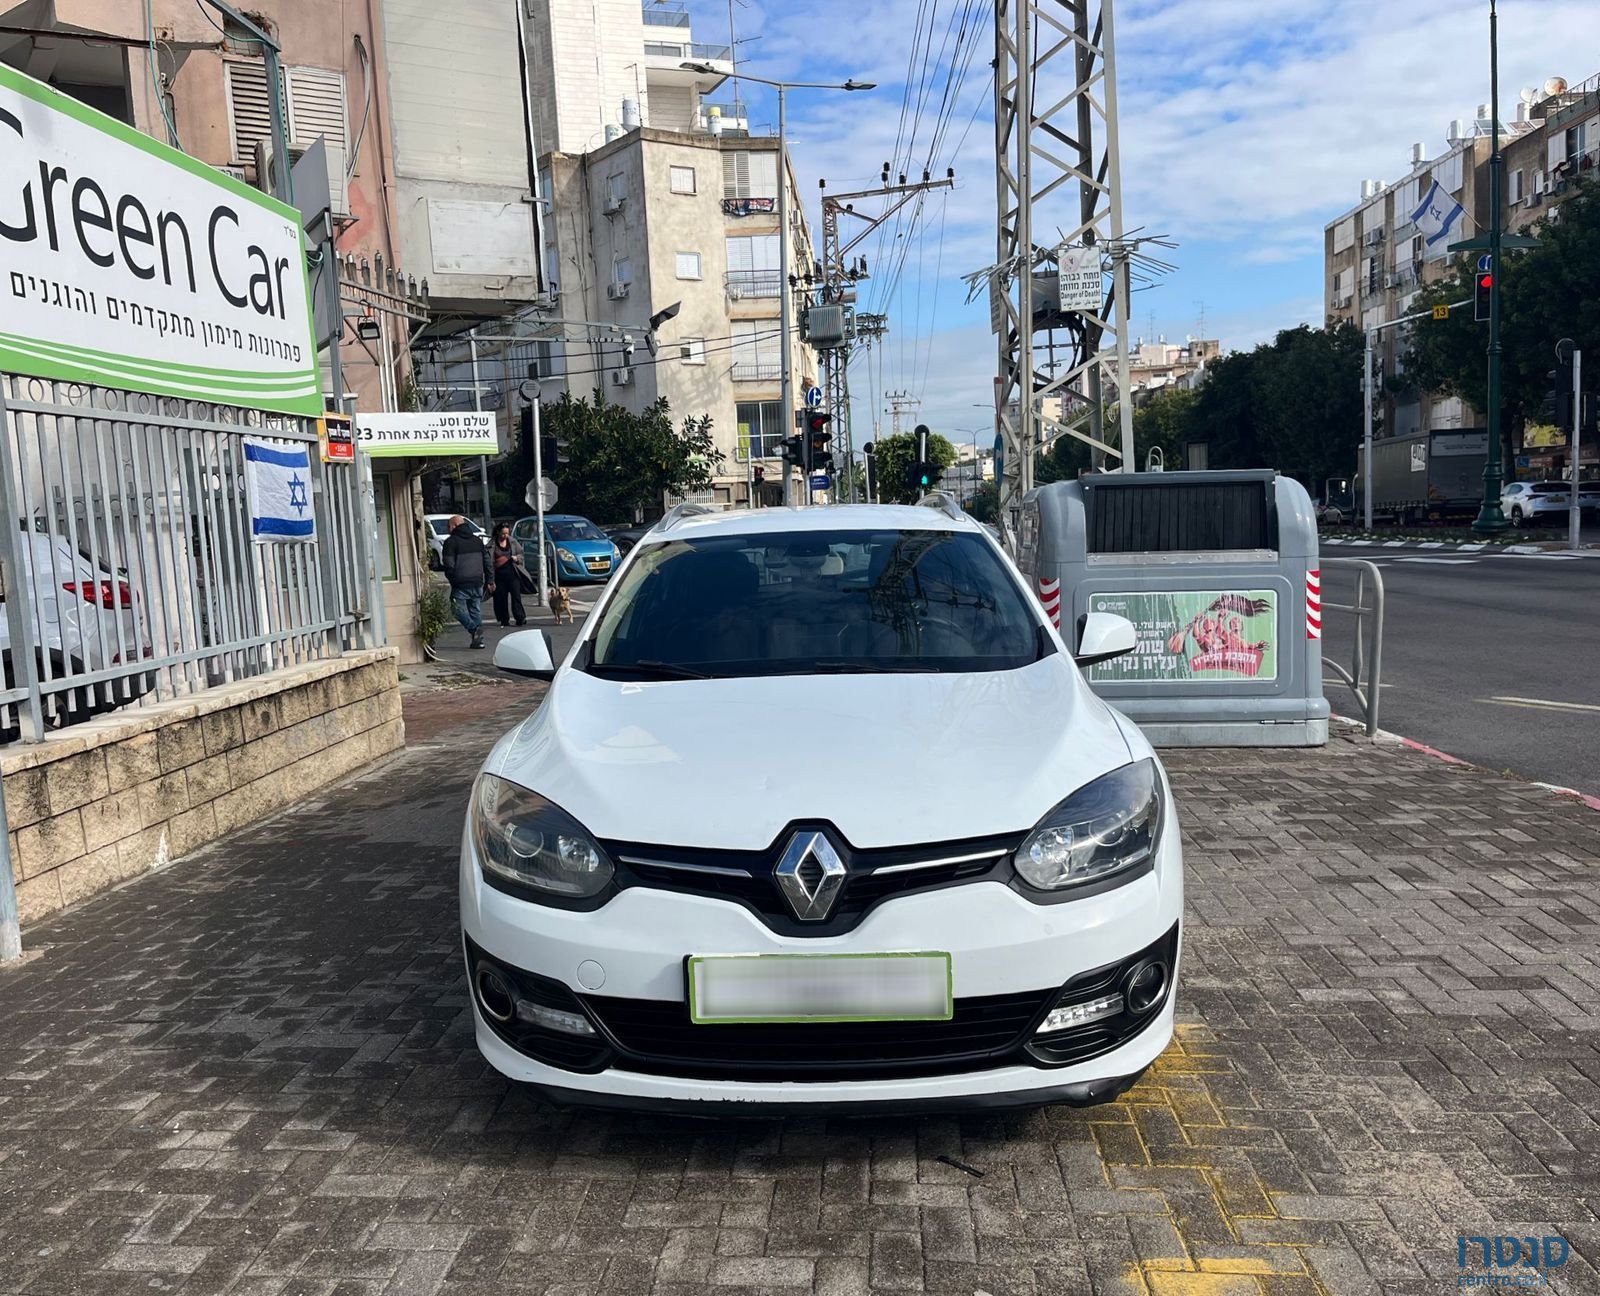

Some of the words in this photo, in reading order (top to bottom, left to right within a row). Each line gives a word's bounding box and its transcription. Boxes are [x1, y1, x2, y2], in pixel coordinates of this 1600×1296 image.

[0, 106, 197, 294] Green
[208, 205, 289, 320] Car
[1083, 271, 1100, 280] מתח
[1081, 280, 1100, 290] סכנת
[10, 271, 97, 315] והוגנים
[1060, 291, 1078, 301] Danger
[1078, 290, 1084, 298] of
[106, 296, 195, 338] מתקדמים
[1435, 307, 1446, 317] 13
[201, 321, 243, 348] מימון
[249, 333, 301, 363] פתרונות
[428, 417, 459, 427] וסע...
[463, 415, 489, 427] שלם
[377, 430, 410, 440] אחרת
[414, 429, 438, 442] קצת
[442, 429, 455, 439] זה
[459, 427, 490, 439] אצלנו
[1143, 655, 1177, 670] עליה
